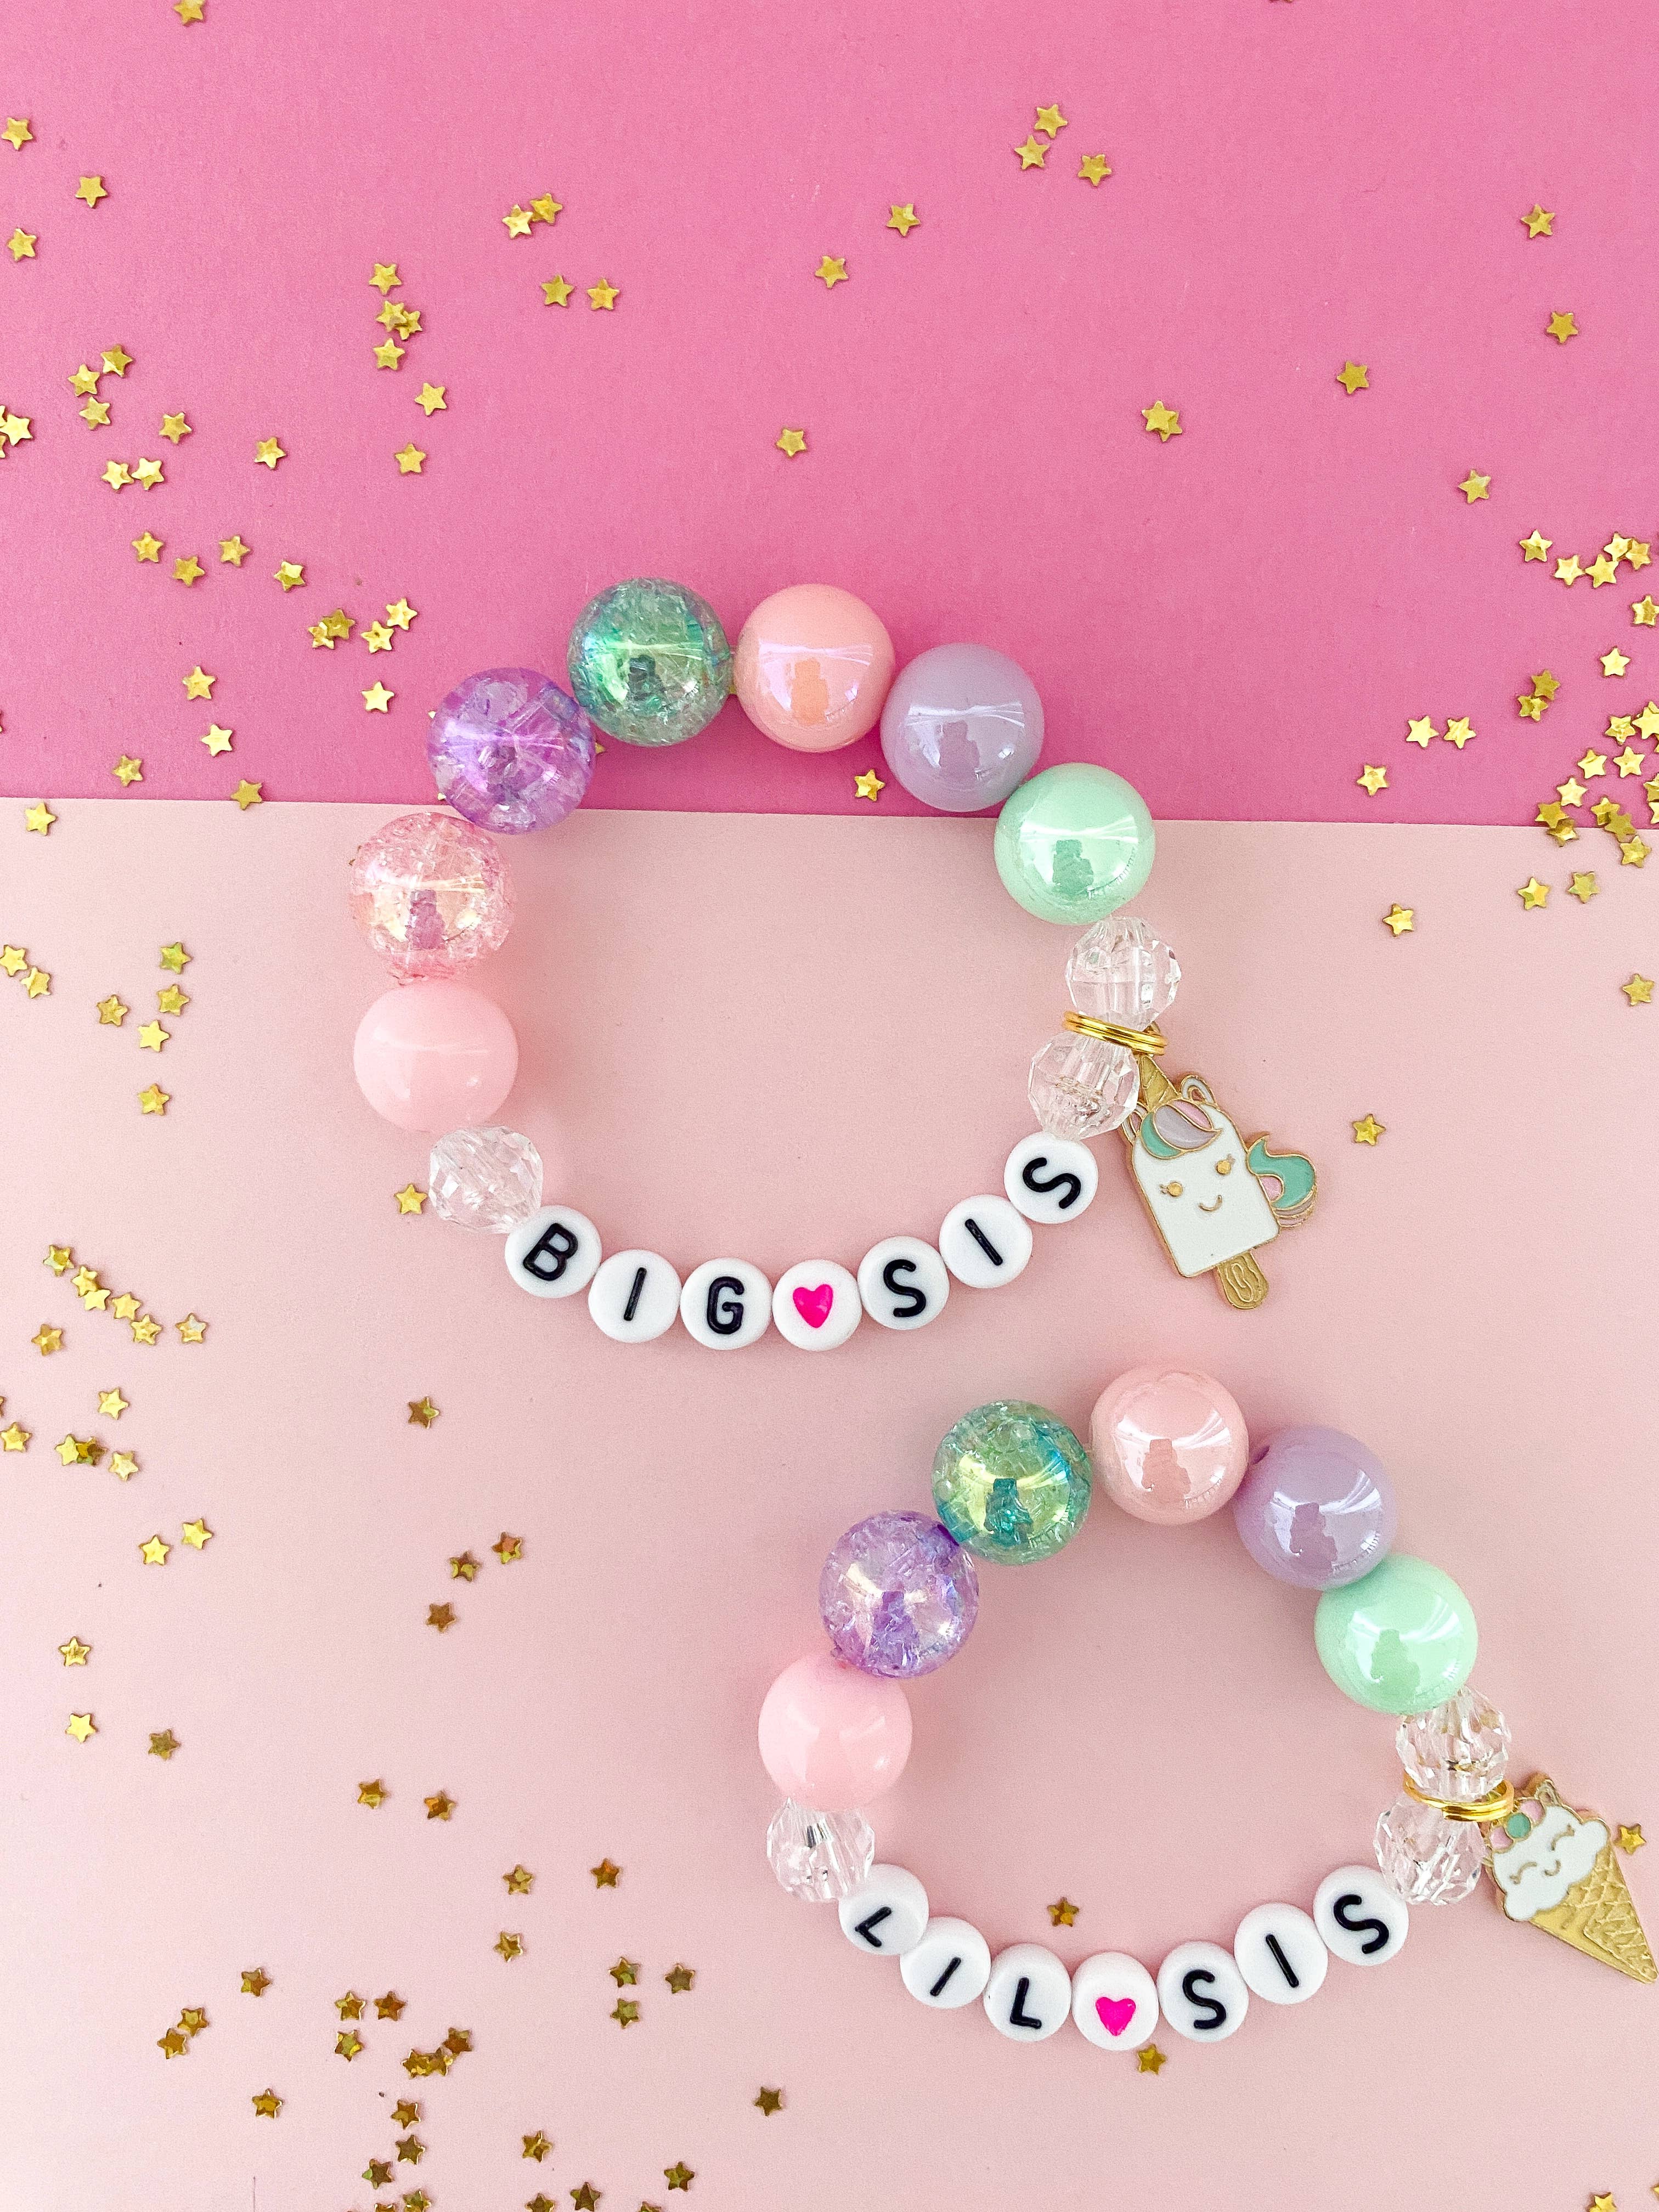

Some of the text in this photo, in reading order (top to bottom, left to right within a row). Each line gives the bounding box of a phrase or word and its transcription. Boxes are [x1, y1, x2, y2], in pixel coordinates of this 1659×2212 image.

[522, 1156, 1082, 1336] BIG SIS
[854, 1893, 1390, 2030] LIL SIS
